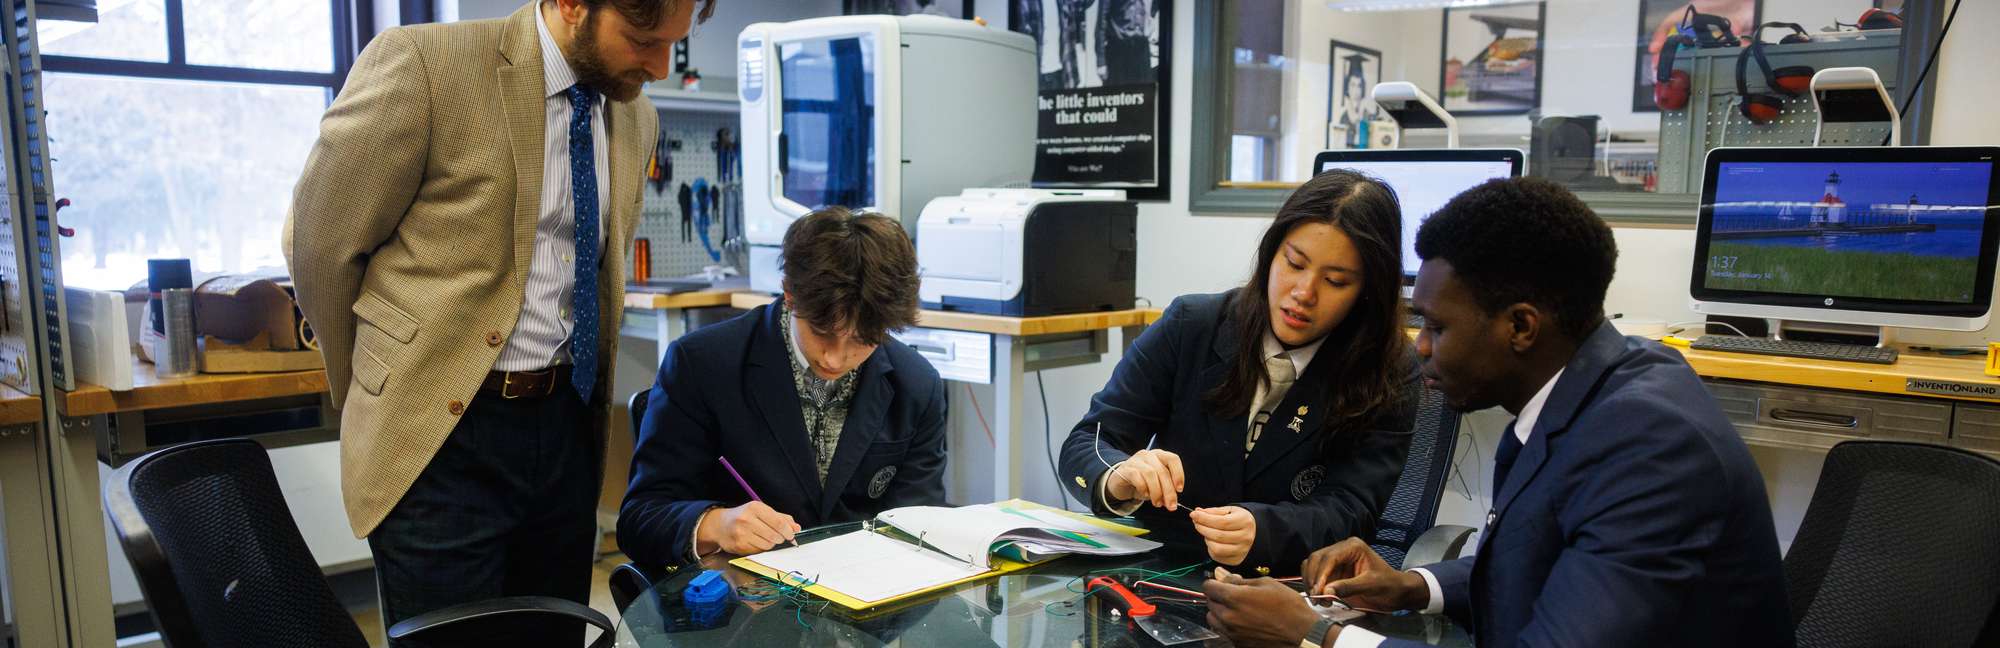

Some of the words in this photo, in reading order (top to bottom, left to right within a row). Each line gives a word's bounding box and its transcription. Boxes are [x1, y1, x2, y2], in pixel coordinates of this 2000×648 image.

[1038, 95, 1054, 110] he
[1056, 93, 1084, 109] little
[1087, 92, 1145, 108] inventors
[1055, 109, 1081, 125] that
[1083, 107, 1118, 123] could
[1711, 255, 1738, 269] 1:37
[1914, 381, 1996, 394] INVENTIONLAND
